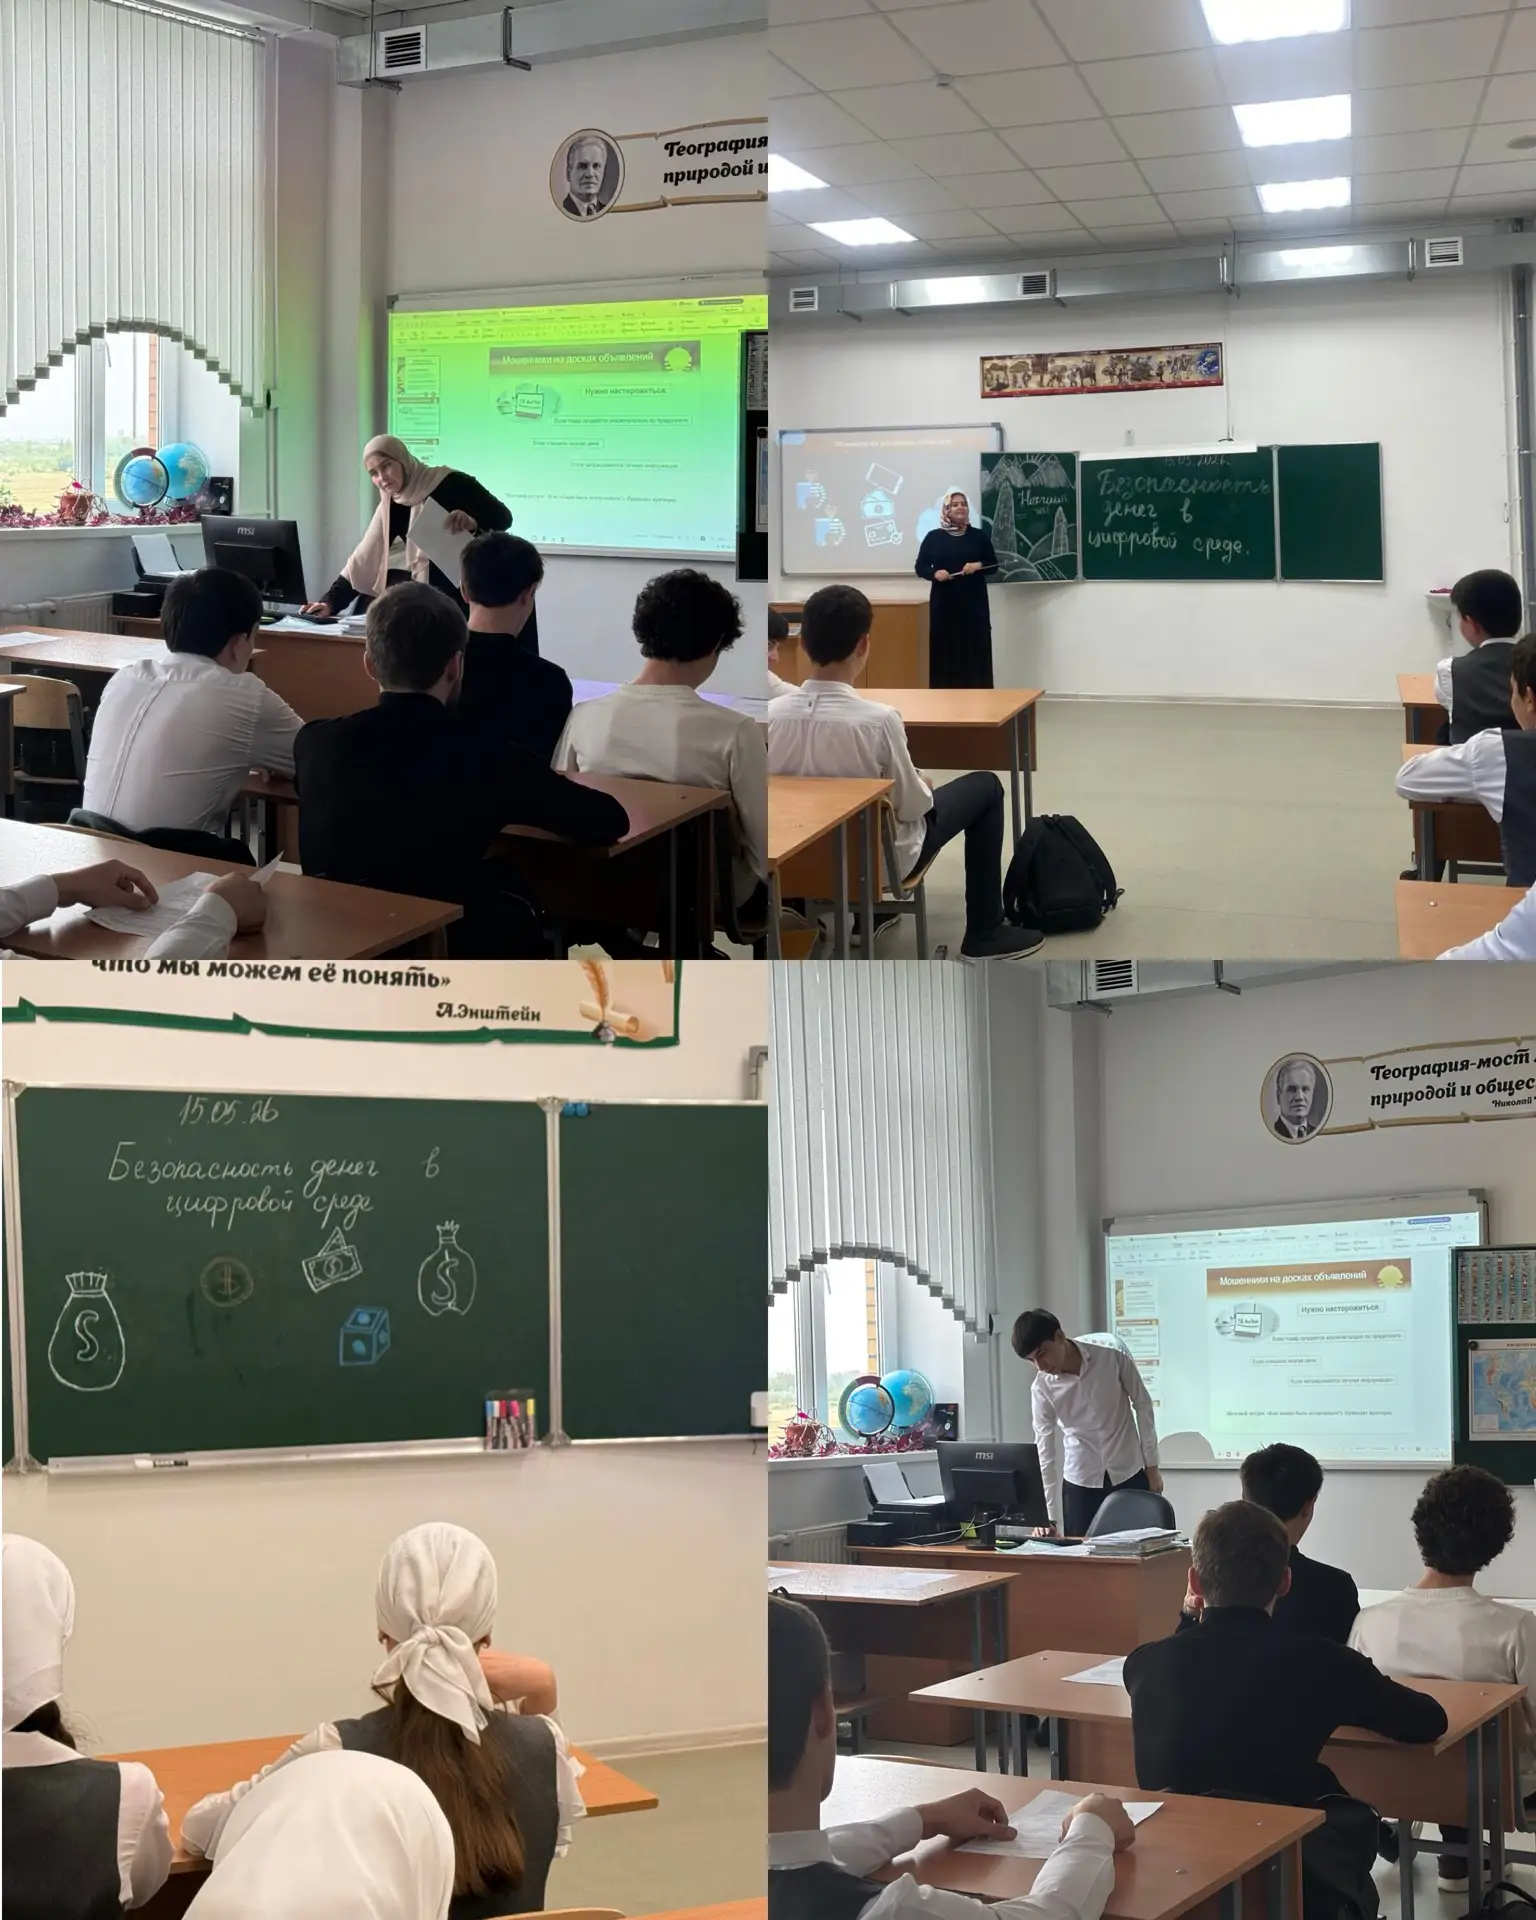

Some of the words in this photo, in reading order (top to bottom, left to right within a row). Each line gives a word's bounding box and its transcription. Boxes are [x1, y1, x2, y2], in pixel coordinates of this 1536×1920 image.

[664, 136, 768, 157] География
[664, 159, 753, 186] природой
[502, 355, 551, 365] Мошенники
[566, 353, 597, 364] досках
[599, 351, 653, 363] объявлений
[1098, 468, 1271, 499] Безопасность
[1104, 501, 1158, 527] денег
[1180, 498, 1193, 523] в
[237, 527, 255, 535] msi
[1088, 522, 1177, 558] цифровой
[157, 960, 201, 976] мы
[206, 962, 302, 981] можем
[308, 963, 337, 982] её
[342, 966, 452, 988] понять»
[436, 1002, 541, 1022] А.Энштейн
[1370, 1048, 1530, 1081] География-мост
[1370, 1082, 1456, 1109] природой
[1460, 1085, 1471, 1097] и
[1492, 1096, 1533, 1107] Николай
[108, 1141, 294, 1184] Безопасность
[303, 1159, 380, 1199] денег
[421, 1146, 440, 1178] в
[166, 1185, 294, 1232] цифровой
[313, 1193, 374, 1231] среде
[1219, 1275, 1268, 1286] Мошенники
[1270, 1275, 1281, 1284] на
[1282, 1274, 1312, 1284] досках
[1314, 1270, 1367, 1282] объявлений
[1301, 1306, 1325, 1314] Нужно
[975, 1452, 994, 1461] msi
